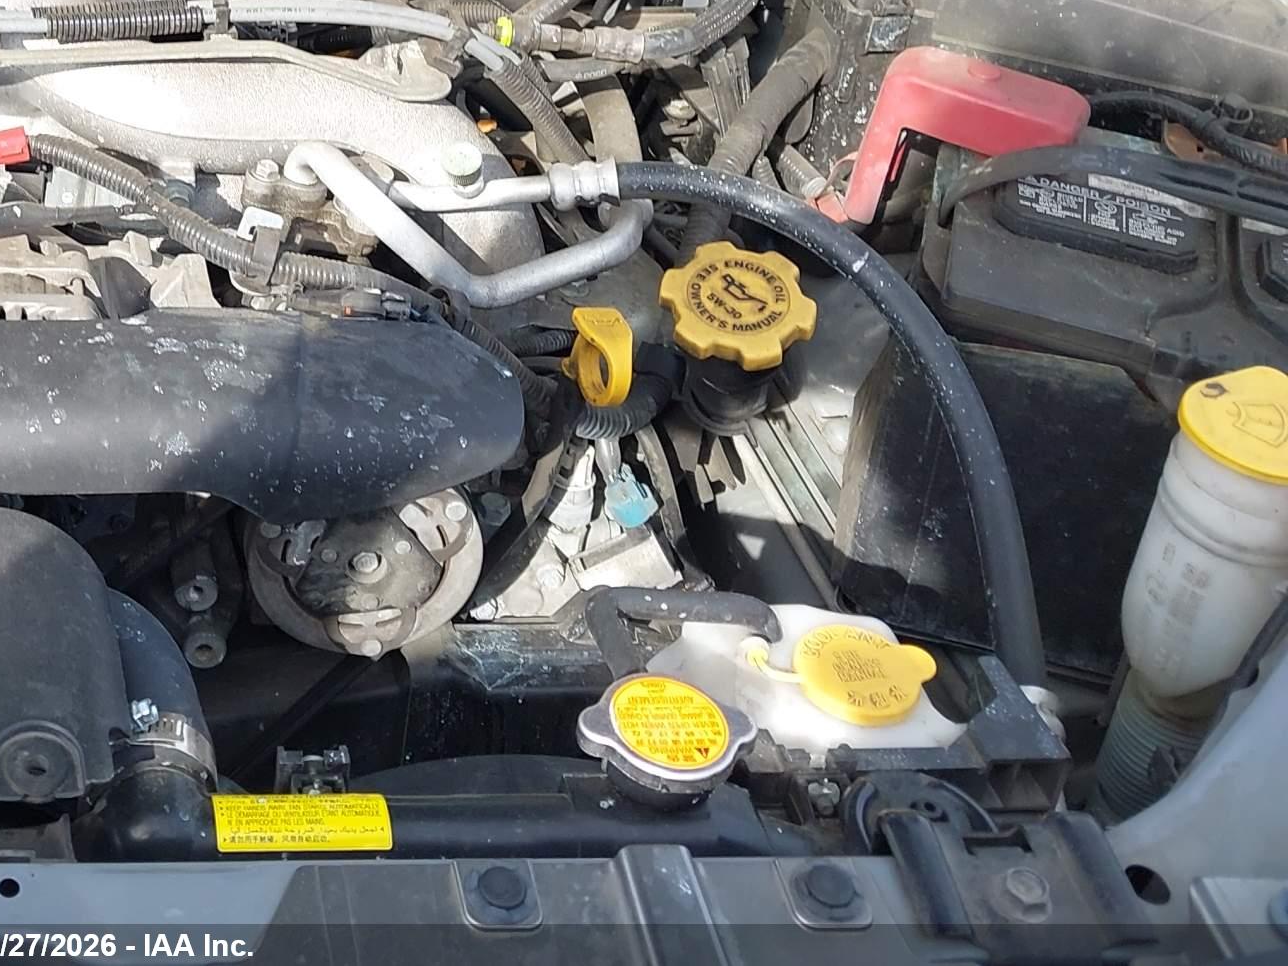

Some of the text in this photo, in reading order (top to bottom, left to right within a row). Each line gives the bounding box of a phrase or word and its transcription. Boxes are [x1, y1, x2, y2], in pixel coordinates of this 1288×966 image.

[1115, 195, 1171, 217] POISON
[691, 263, 783, 332] SEE OWNER'S MANUAL
[724, 260, 786, 303] ENGINE OIL
[706, 292, 743, 320] 5W-30
